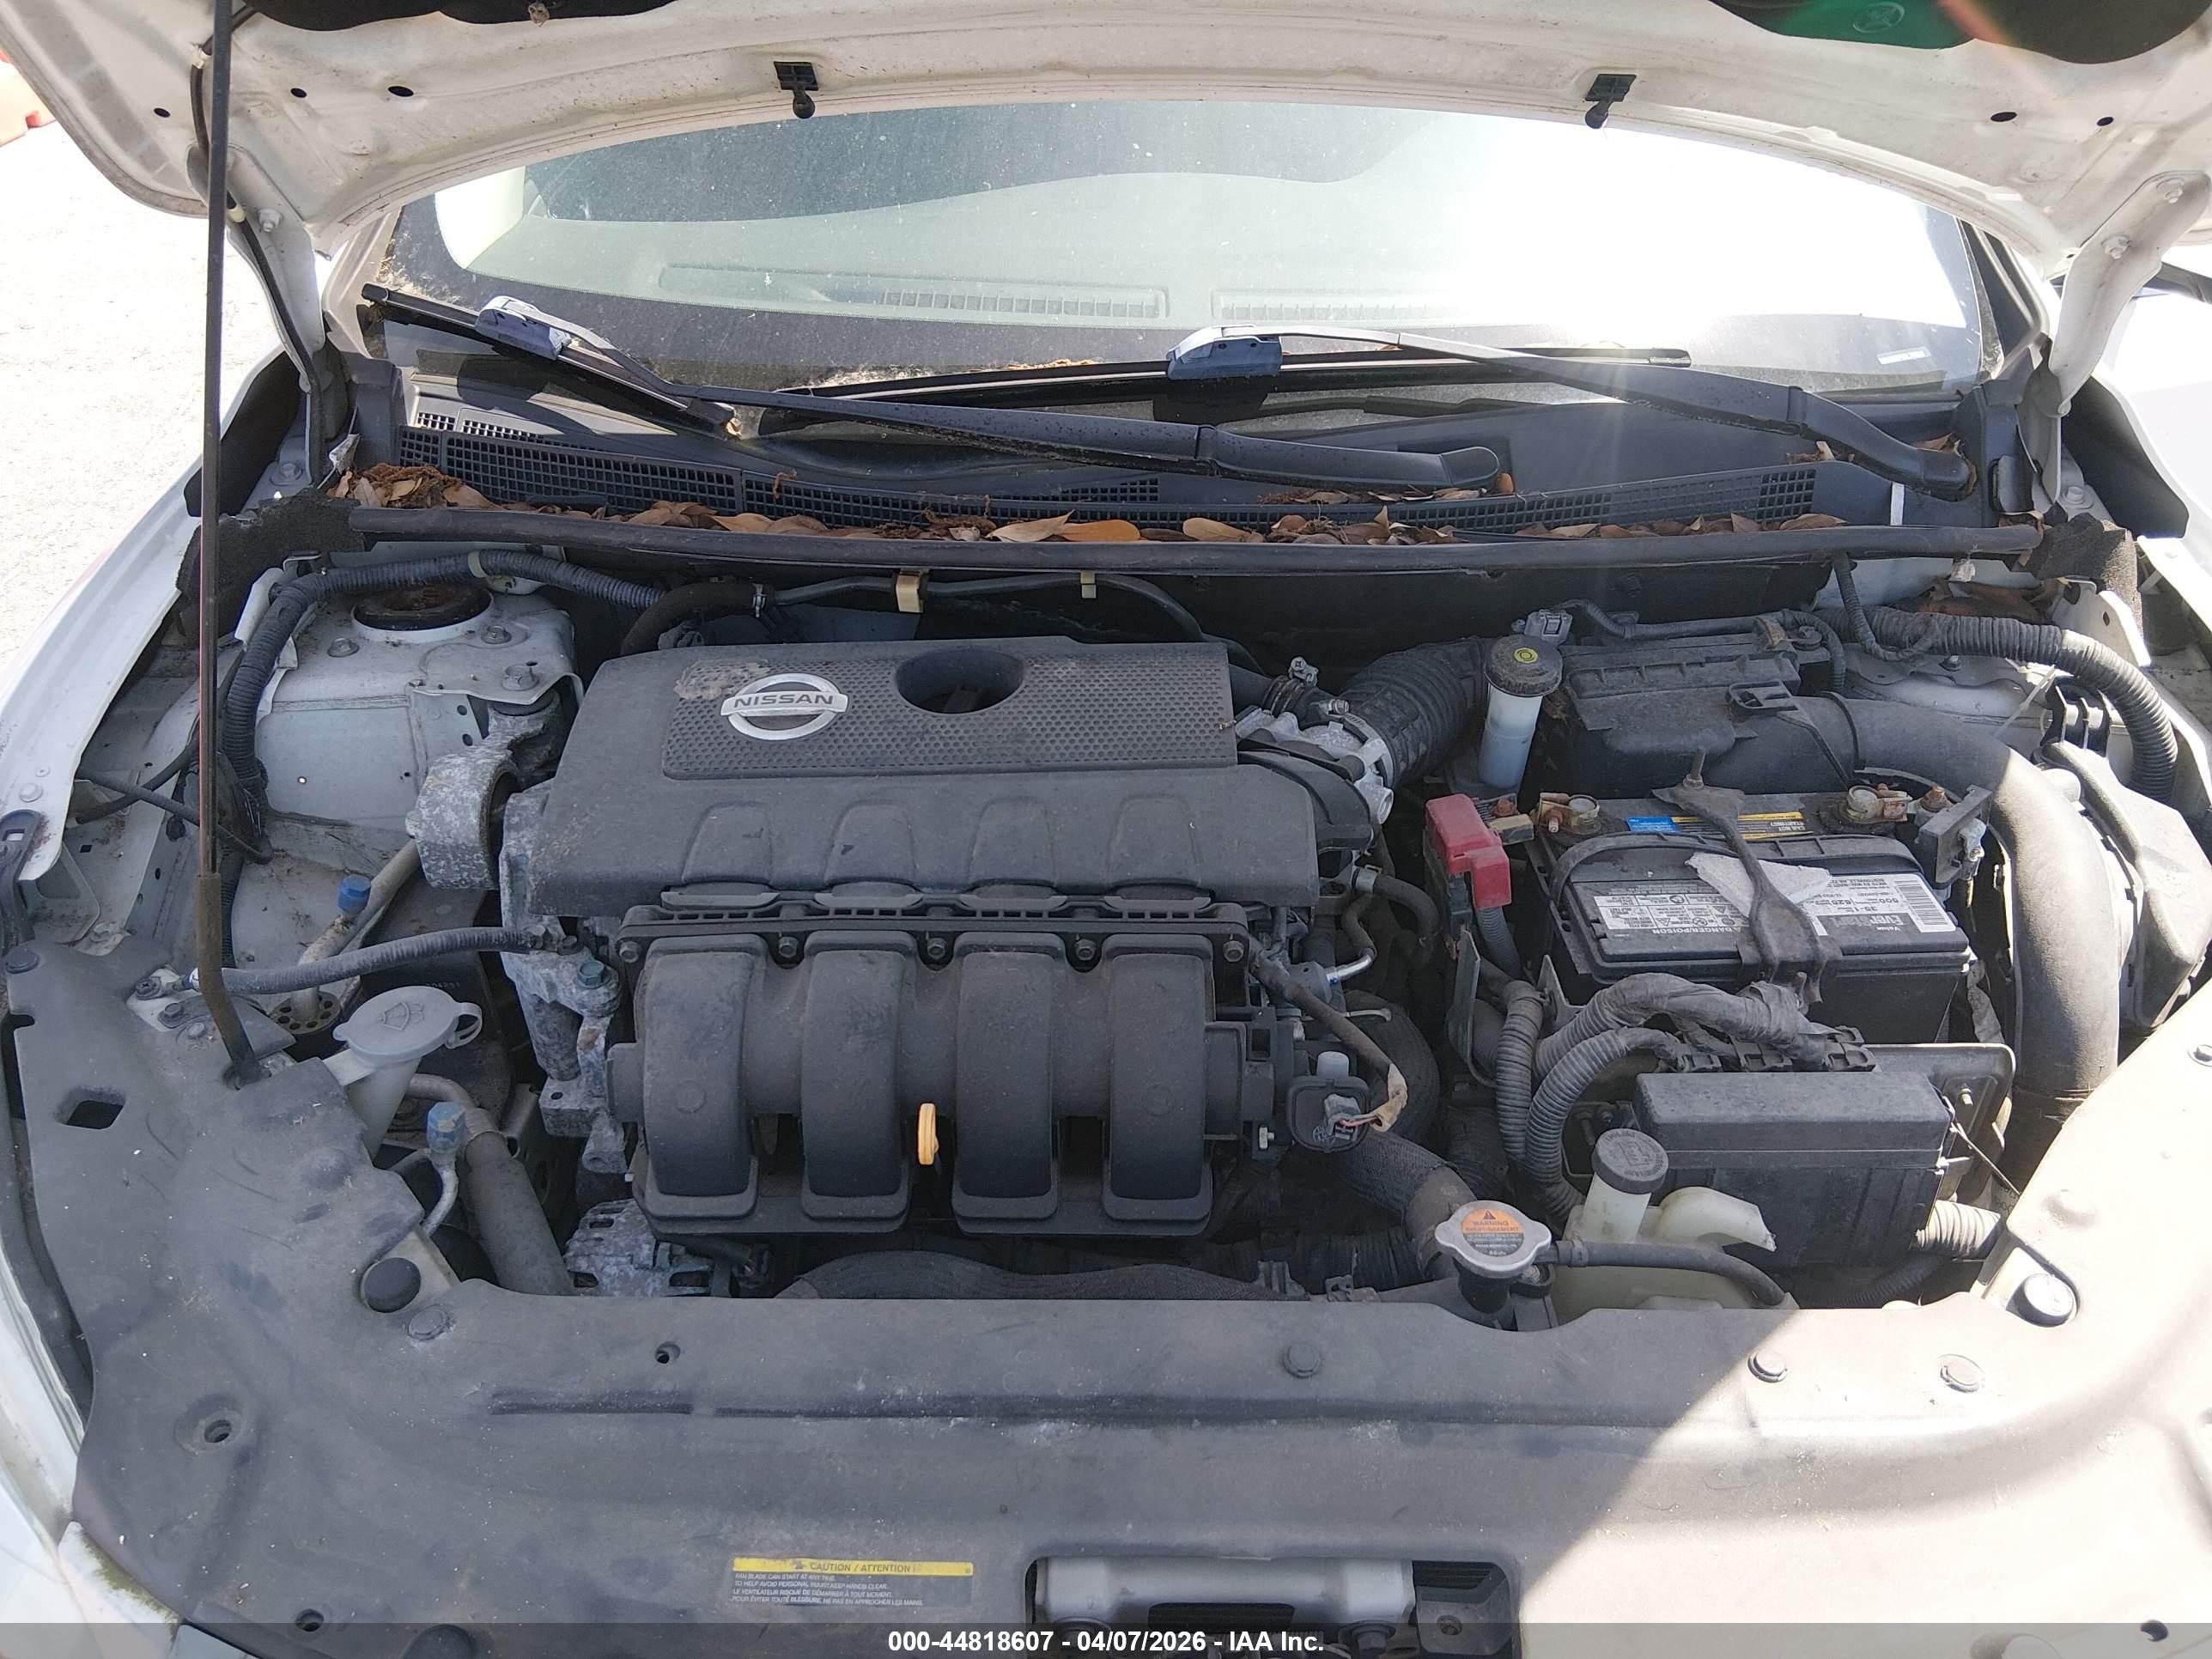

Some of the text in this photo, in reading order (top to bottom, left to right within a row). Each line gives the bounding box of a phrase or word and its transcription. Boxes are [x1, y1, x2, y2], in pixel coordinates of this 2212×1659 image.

[733, 694, 834, 708] NISSAN
[810, 1563, 852, 1572] CAUTION
[860, 1564, 911, 1572] ATTENTION
